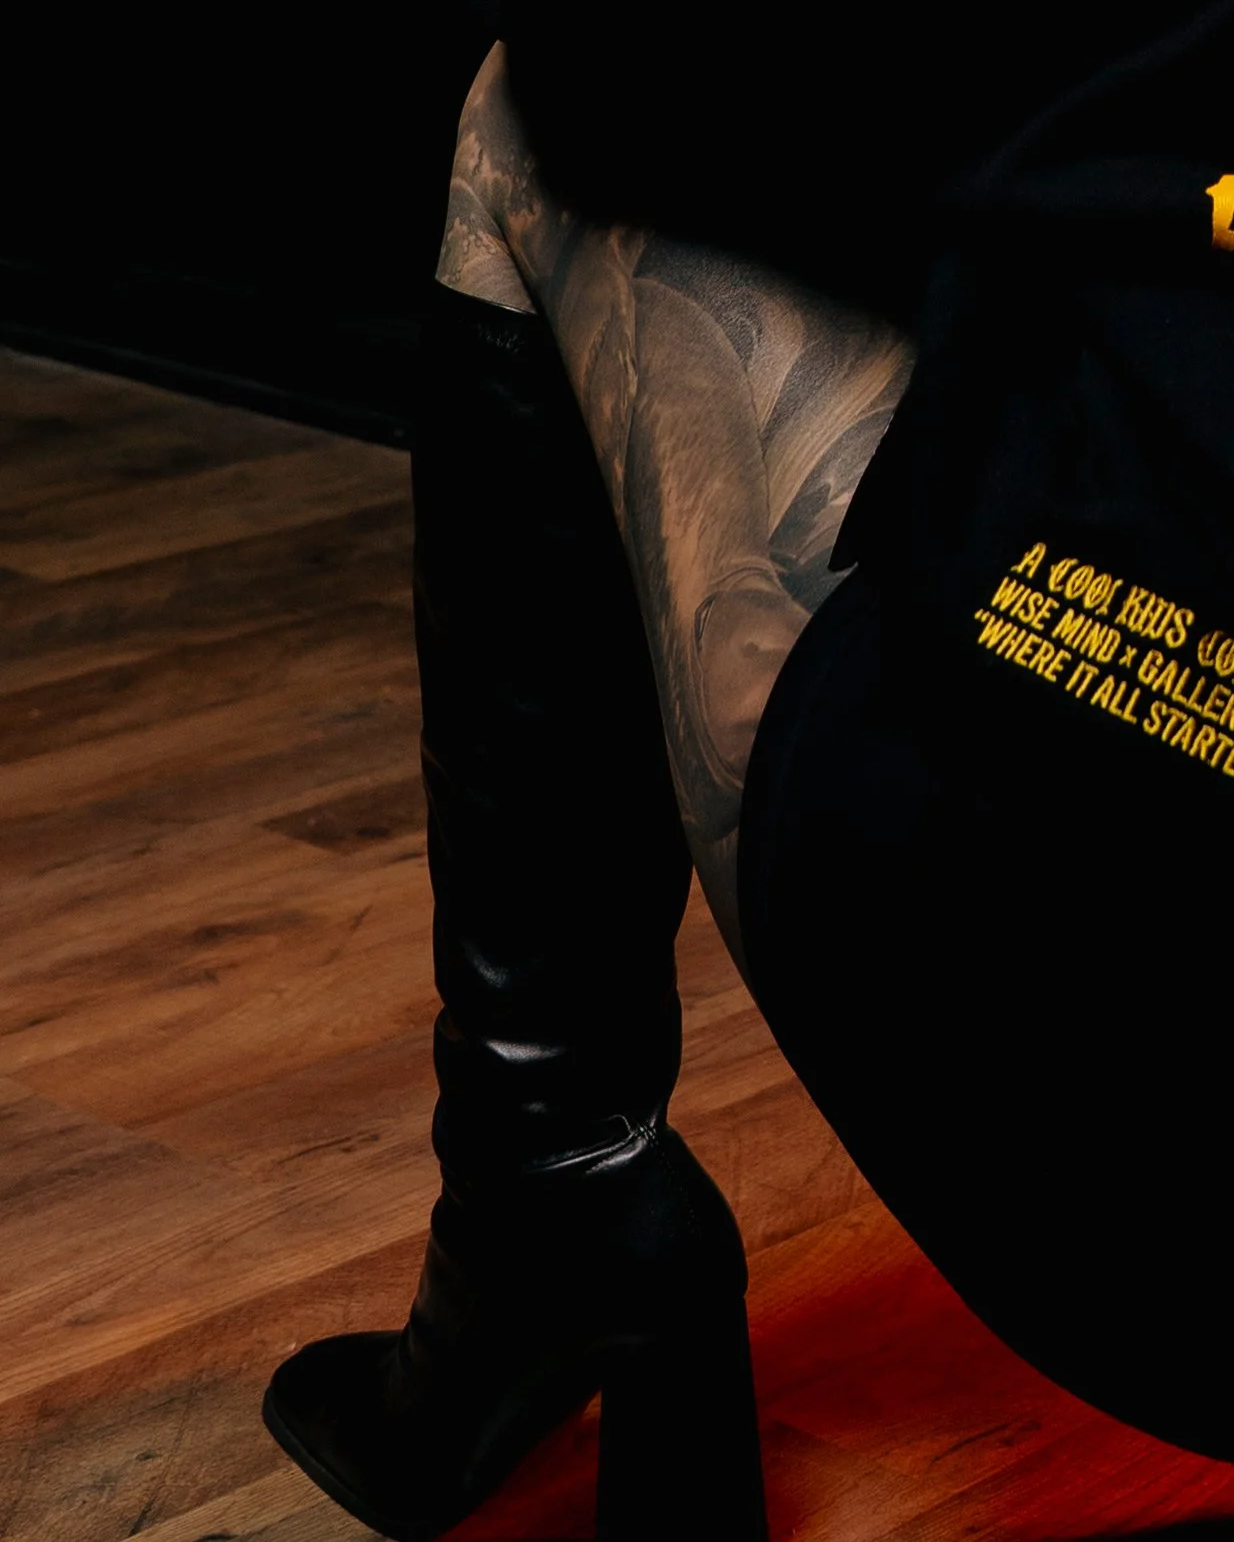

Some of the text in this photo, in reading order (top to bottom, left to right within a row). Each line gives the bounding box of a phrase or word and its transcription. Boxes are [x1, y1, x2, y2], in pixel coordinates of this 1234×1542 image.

[991, 577, 1060, 630] WISE
[1051, 608, 1121, 663] MIND
[1011, 541, 1046, 578] A
[1048, 557, 1123, 615] COOL
[1115, 586, 1194, 648] KIDS
[1065, 661, 1099, 698] IT
[1091, 675, 1140, 723] ALL
